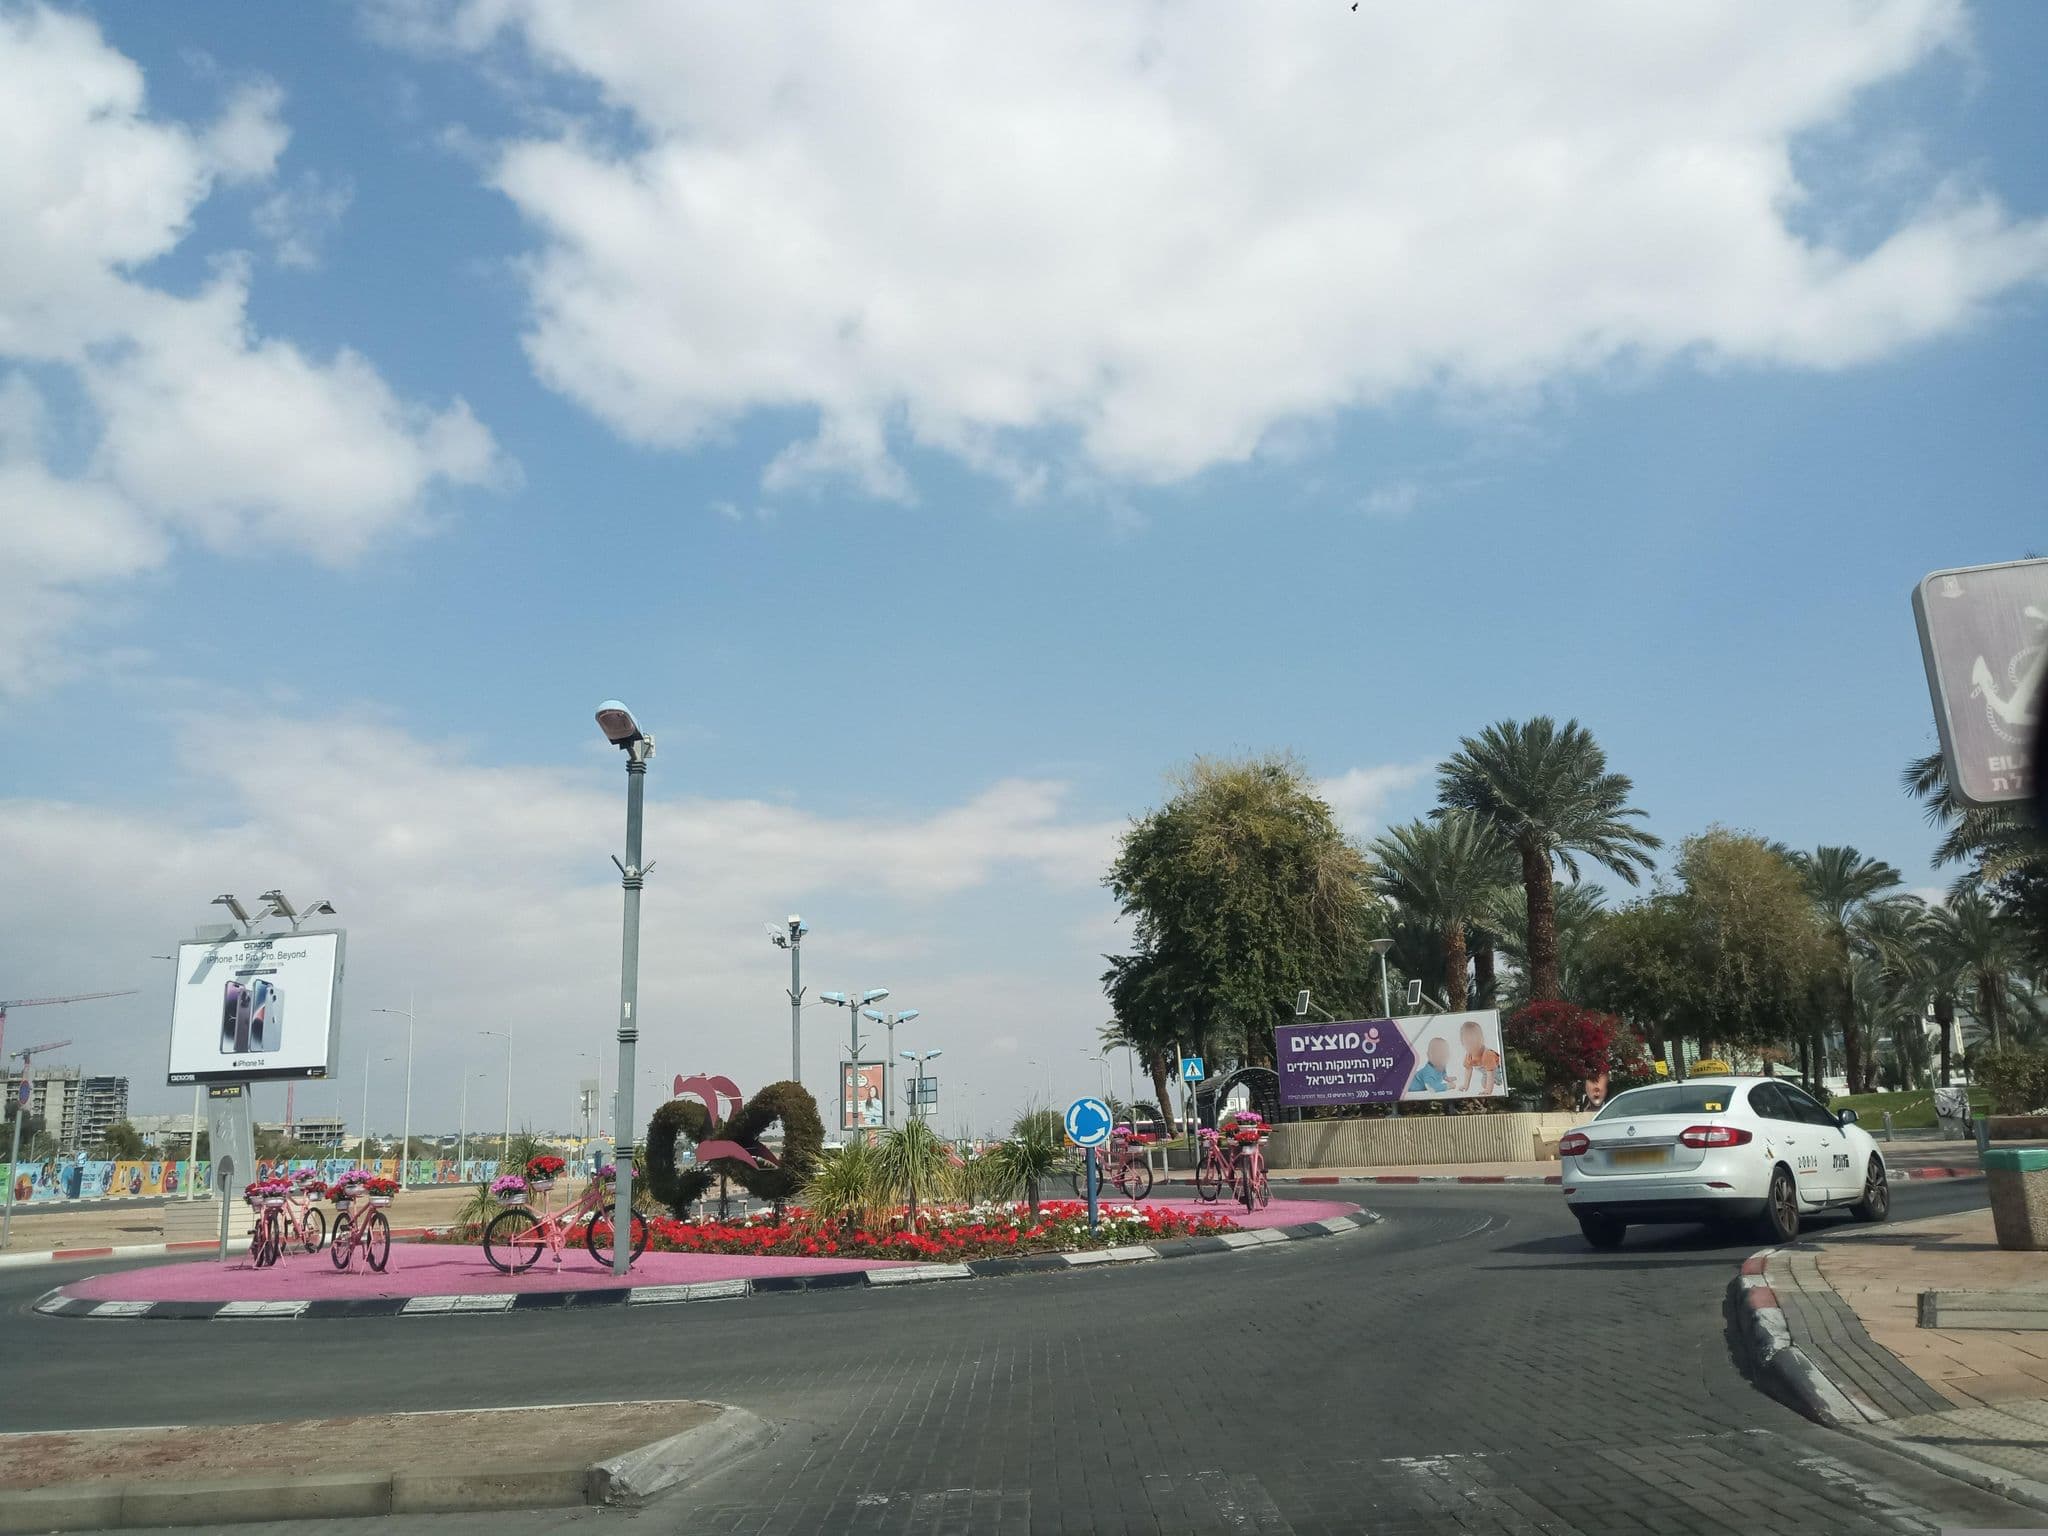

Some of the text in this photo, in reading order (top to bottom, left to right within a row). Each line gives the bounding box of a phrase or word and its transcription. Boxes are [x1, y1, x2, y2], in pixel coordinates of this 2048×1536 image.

[207, 954, 232, 963] iPhone
[277, 950, 306, 961] Beyond
[1291, 1032, 1360, 1052] מוצצים
[1287, 1057, 1393, 1072] קניון התינוקות והילדים
[1306, 1073, 1376, 1086] הגדול בישראל
